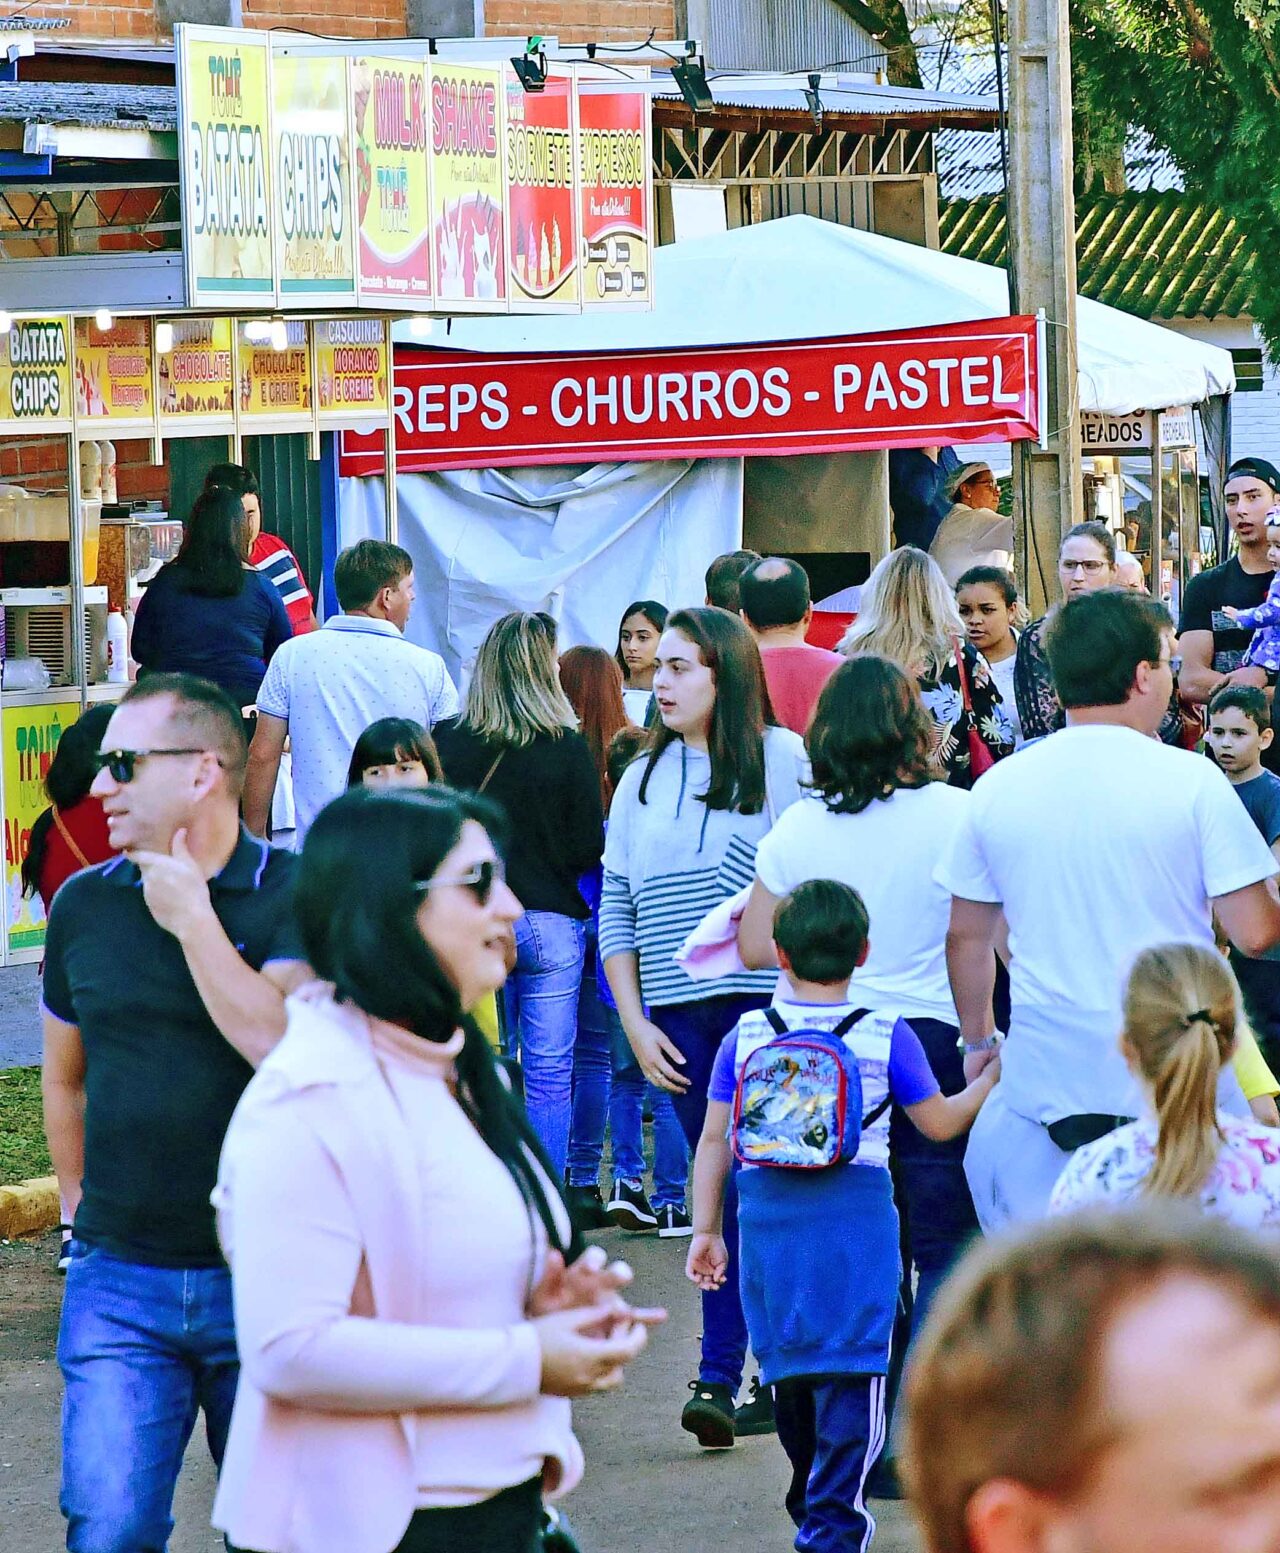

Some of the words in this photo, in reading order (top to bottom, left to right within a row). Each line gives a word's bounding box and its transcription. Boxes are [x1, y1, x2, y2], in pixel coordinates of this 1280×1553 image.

[374, 69, 425, 152] MILK
[432, 75, 496, 158] SHAKE
[506, 123, 571, 189] SORVETE
[579, 128, 645, 189] EXPRESSO
[187, 121, 268, 238] BATATA
[279, 130, 343, 241] CHIPS
[9, 322, 67, 368] BATATA
[328, 320, 385, 345] CASQUINHA
[173, 350, 231, 384] CHOCOLATE
[252, 350, 307, 377] CHOCOLATE
[333, 347, 379, 374] MORANGO
[10, 369, 60, 417] CHIPS
[260, 379, 267, 406] E
[268, 377, 300, 406] CREME
[334, 375, 342, 402] E
[343, 375, 374, 402] CREME
[551, 366, 792, 427] CHURROS
[834, 354, 1020, 413] PASTEL
